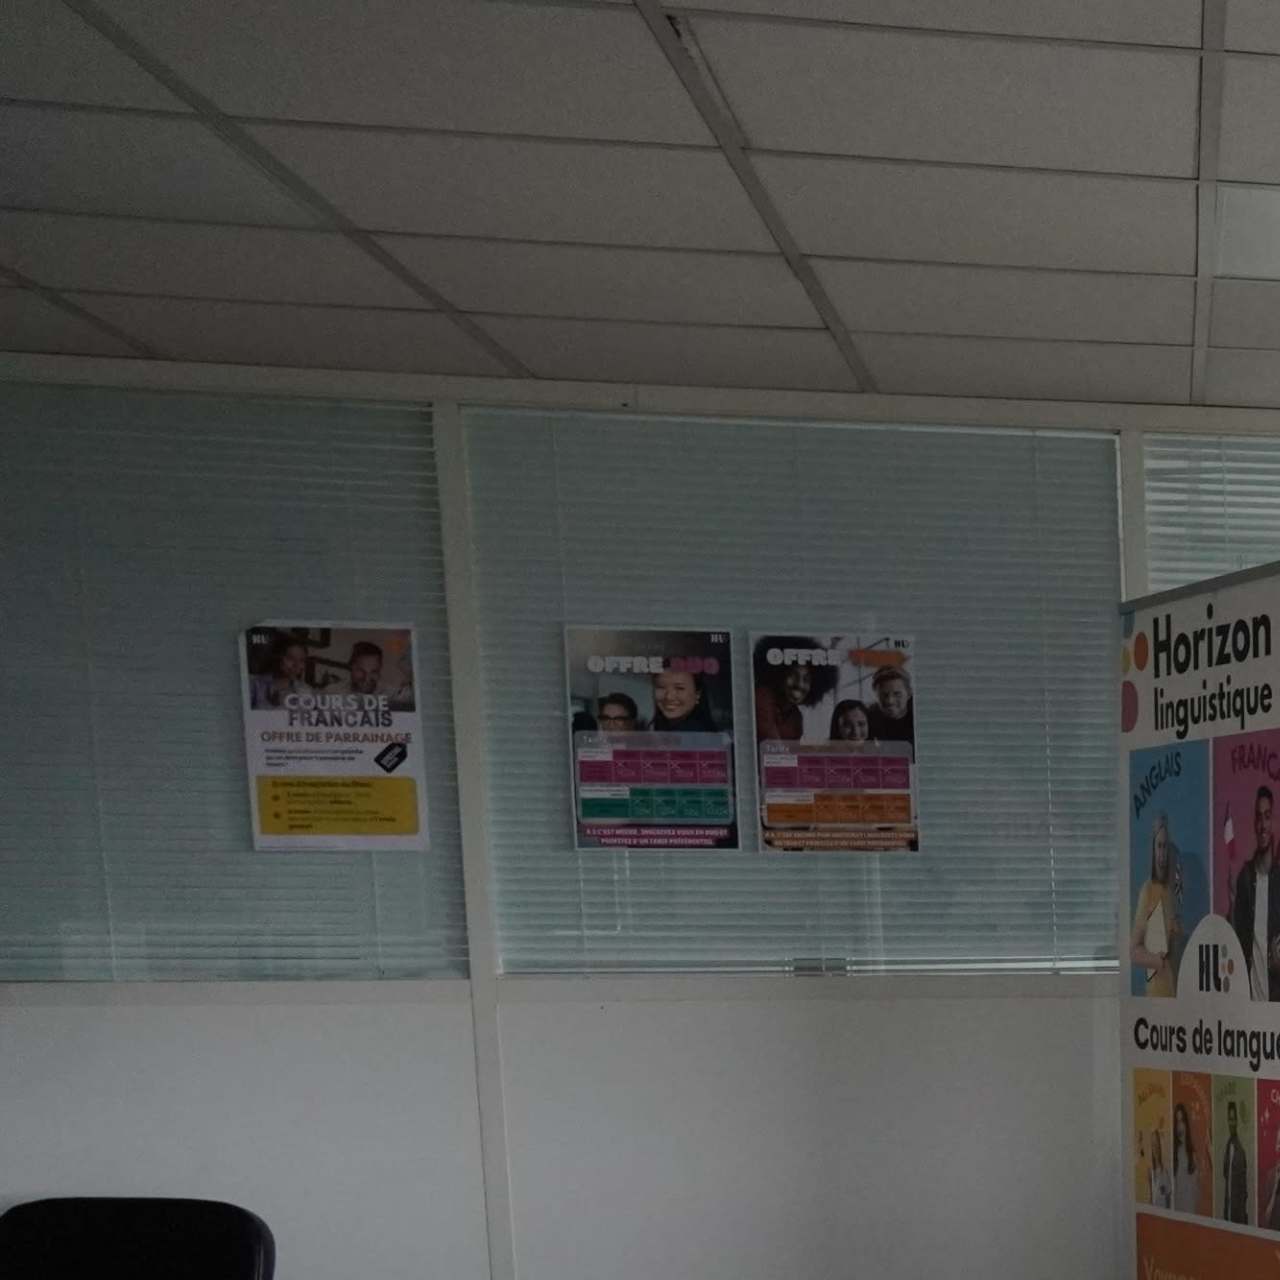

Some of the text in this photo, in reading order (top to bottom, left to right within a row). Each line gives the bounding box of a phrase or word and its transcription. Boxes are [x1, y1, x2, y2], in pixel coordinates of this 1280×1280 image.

[1152, 603, 1272, 679] Horizon
[587, 655, 664, 674] OFFRE
[284, 694, 390, 711] COURS DE
[1154, 674, 1273, 740] linguistique
[260, 731, 412, 745] OFFRE DE PARRAINAGE
[1132, 751, 1182, 819] ANGLAIS
[1134, 1017, 1187, 1054] Cours
[1192, 1019, 1213, 1055] de
